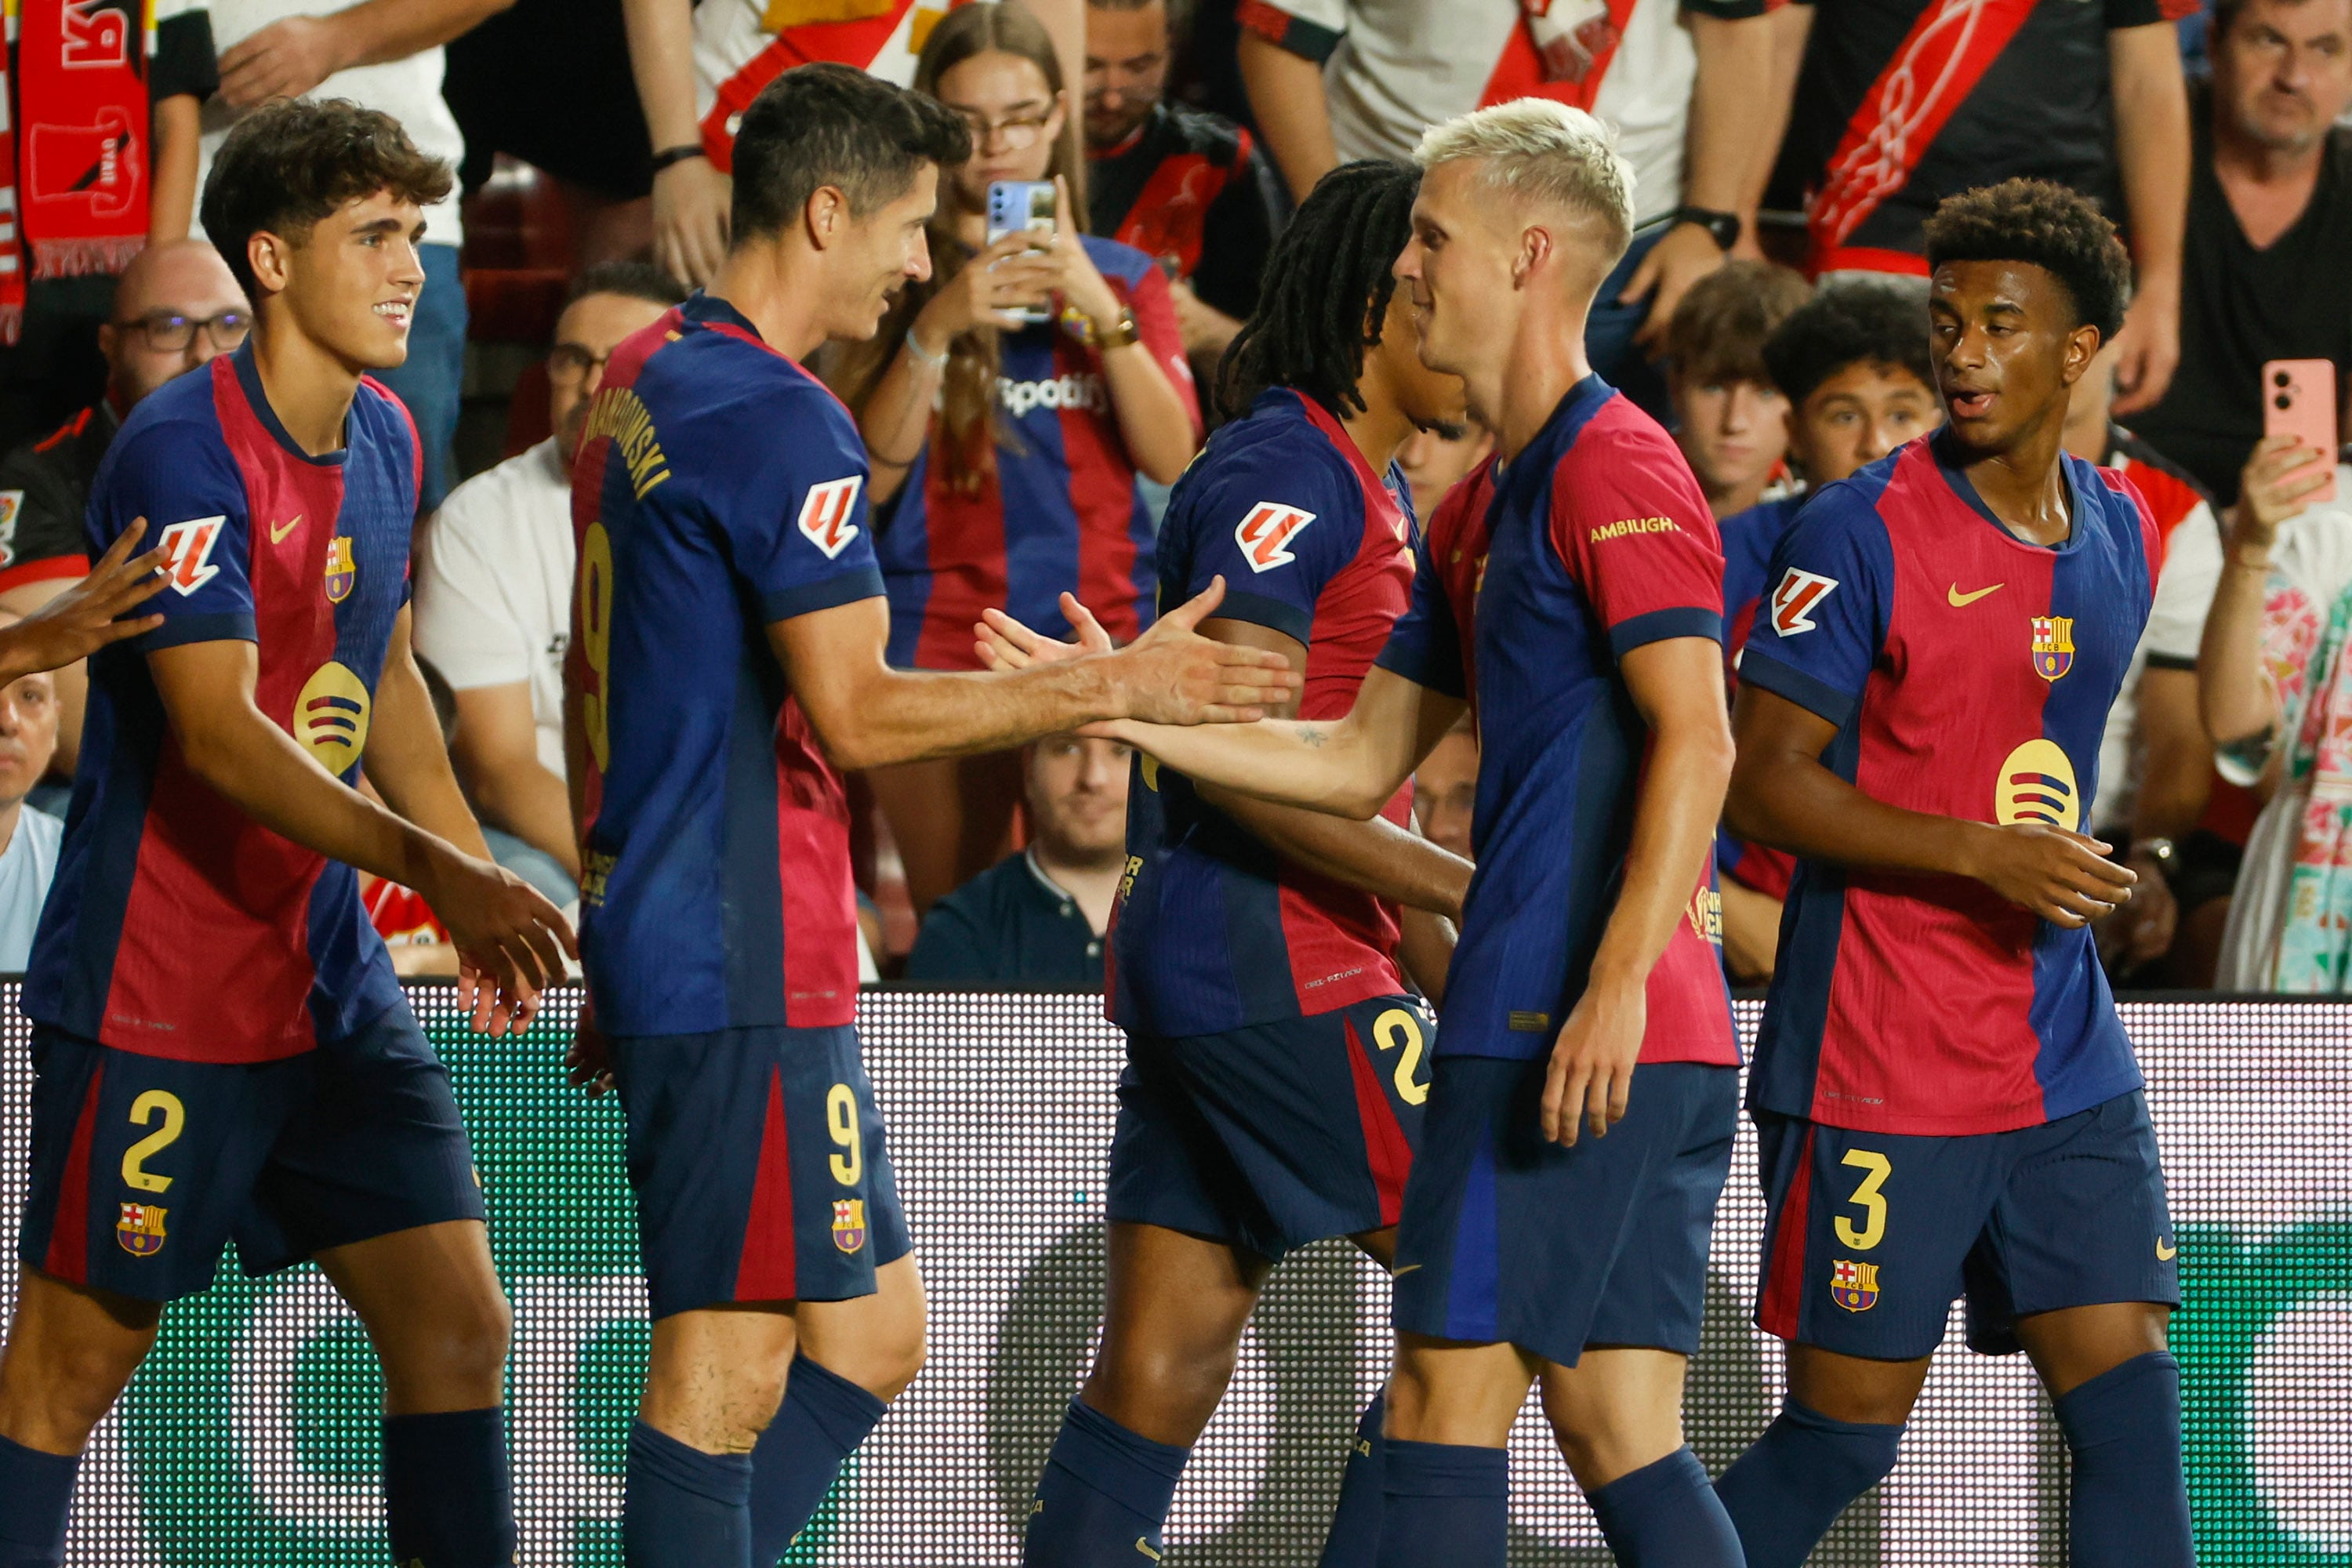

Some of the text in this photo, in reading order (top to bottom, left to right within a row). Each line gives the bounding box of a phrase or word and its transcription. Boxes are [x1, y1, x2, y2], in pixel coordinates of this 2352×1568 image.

[582, 521, 612, 774] 9
[122, 1089, 185, 1193] 2
[826, 1083, 862, 1186] 9
[1835, 1148, 1893, 1250] 3
